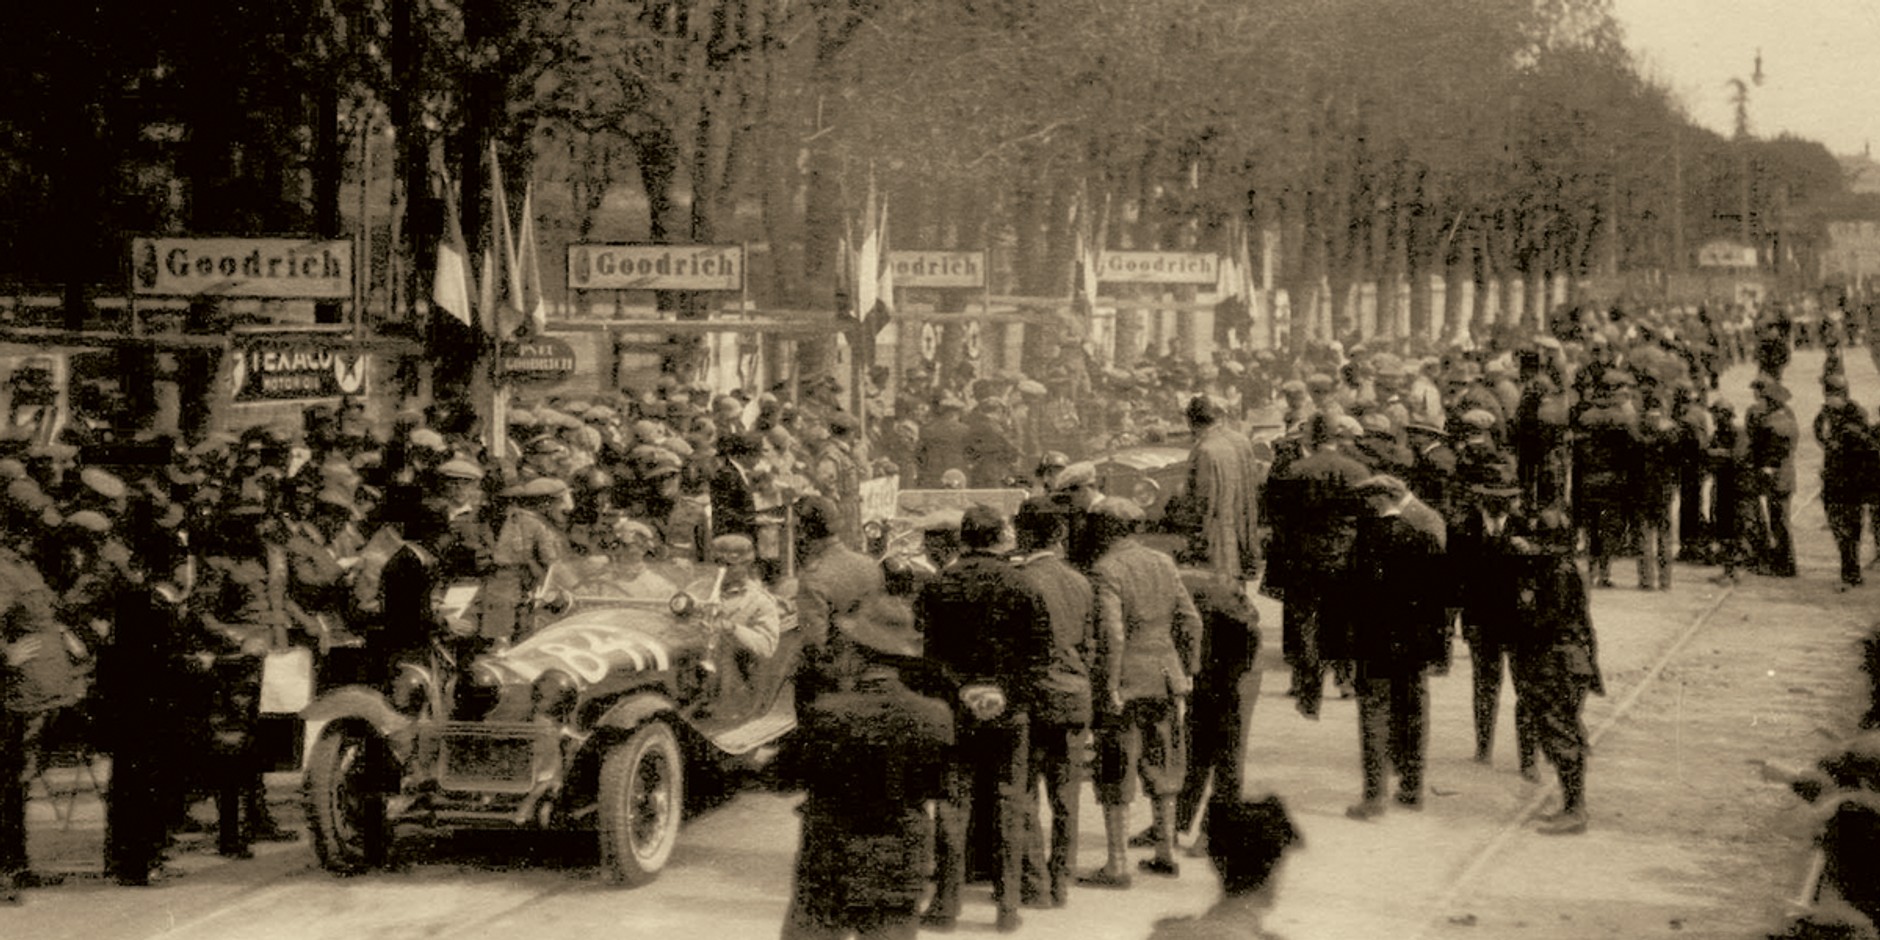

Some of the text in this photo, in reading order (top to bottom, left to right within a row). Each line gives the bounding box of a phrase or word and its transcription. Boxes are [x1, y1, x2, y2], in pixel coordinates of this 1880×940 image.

[165, 248, 341, 279] Goodrich
[596, 251, 735, 277] Goodrich
[890, 255, 977, 275] odrich
[1108, 255, 1212, 273] Goodrich
